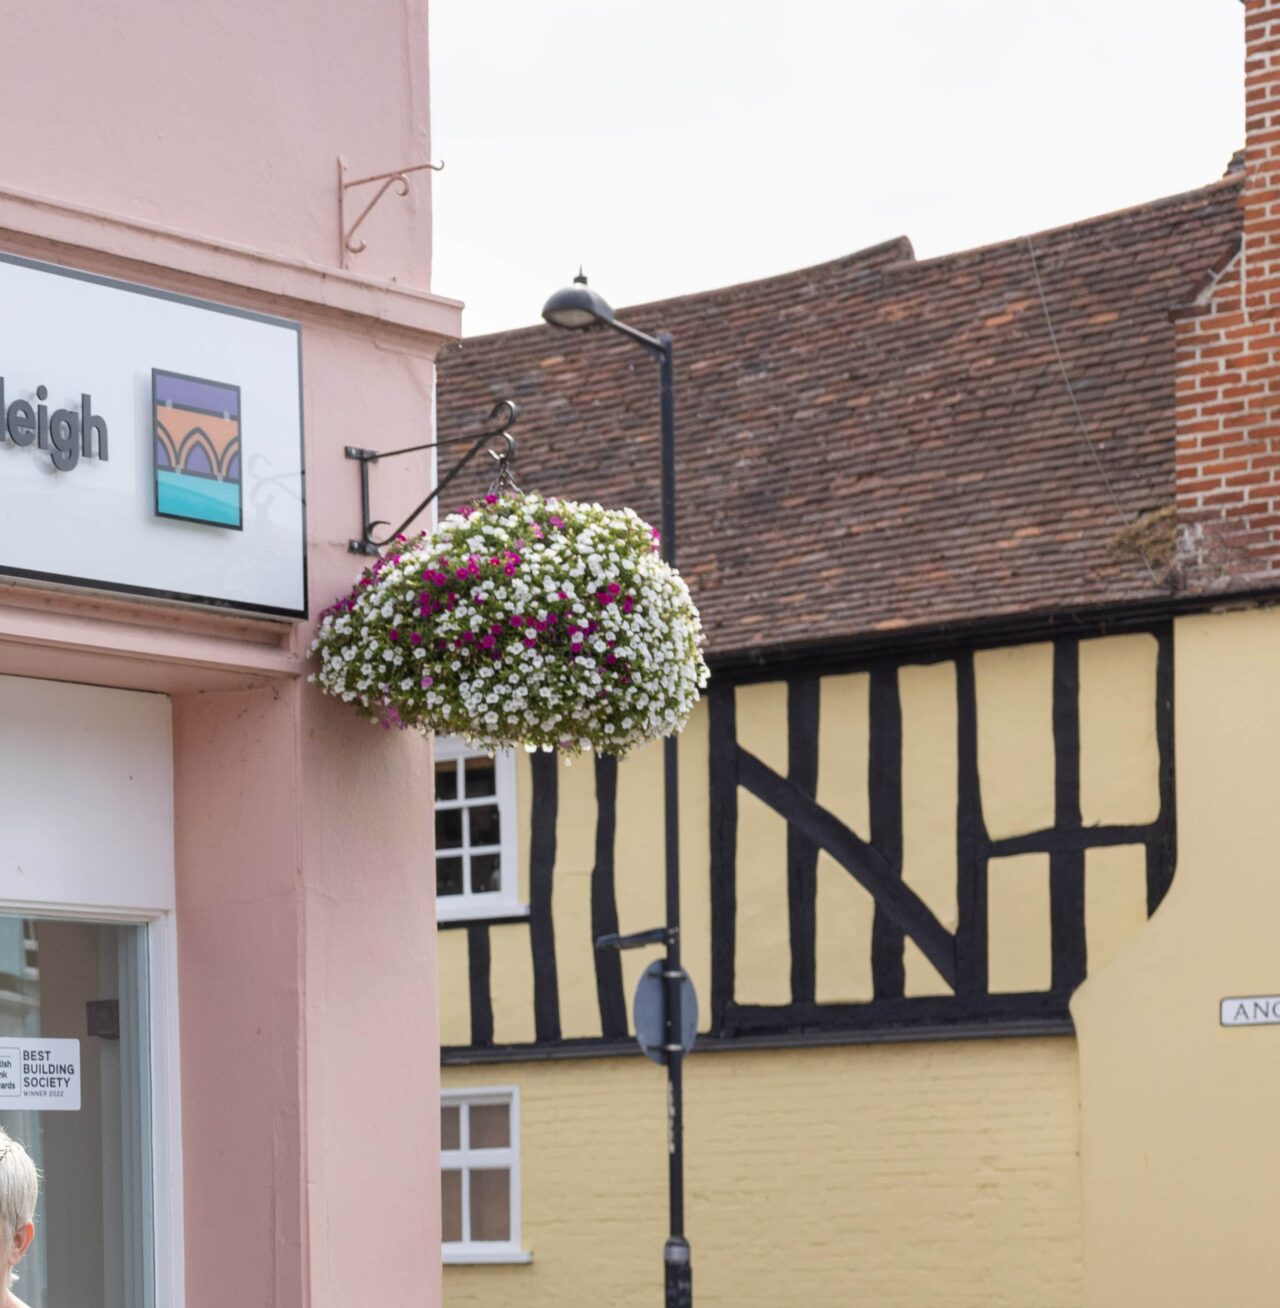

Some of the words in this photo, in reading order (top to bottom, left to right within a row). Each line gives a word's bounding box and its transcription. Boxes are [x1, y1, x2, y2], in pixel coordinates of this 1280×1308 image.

[23, 1051, 51, 1061] BEST
[23, 1064, 75, 1075] BUILDING
[23, 1077, 71, 1088] SOCIETY
